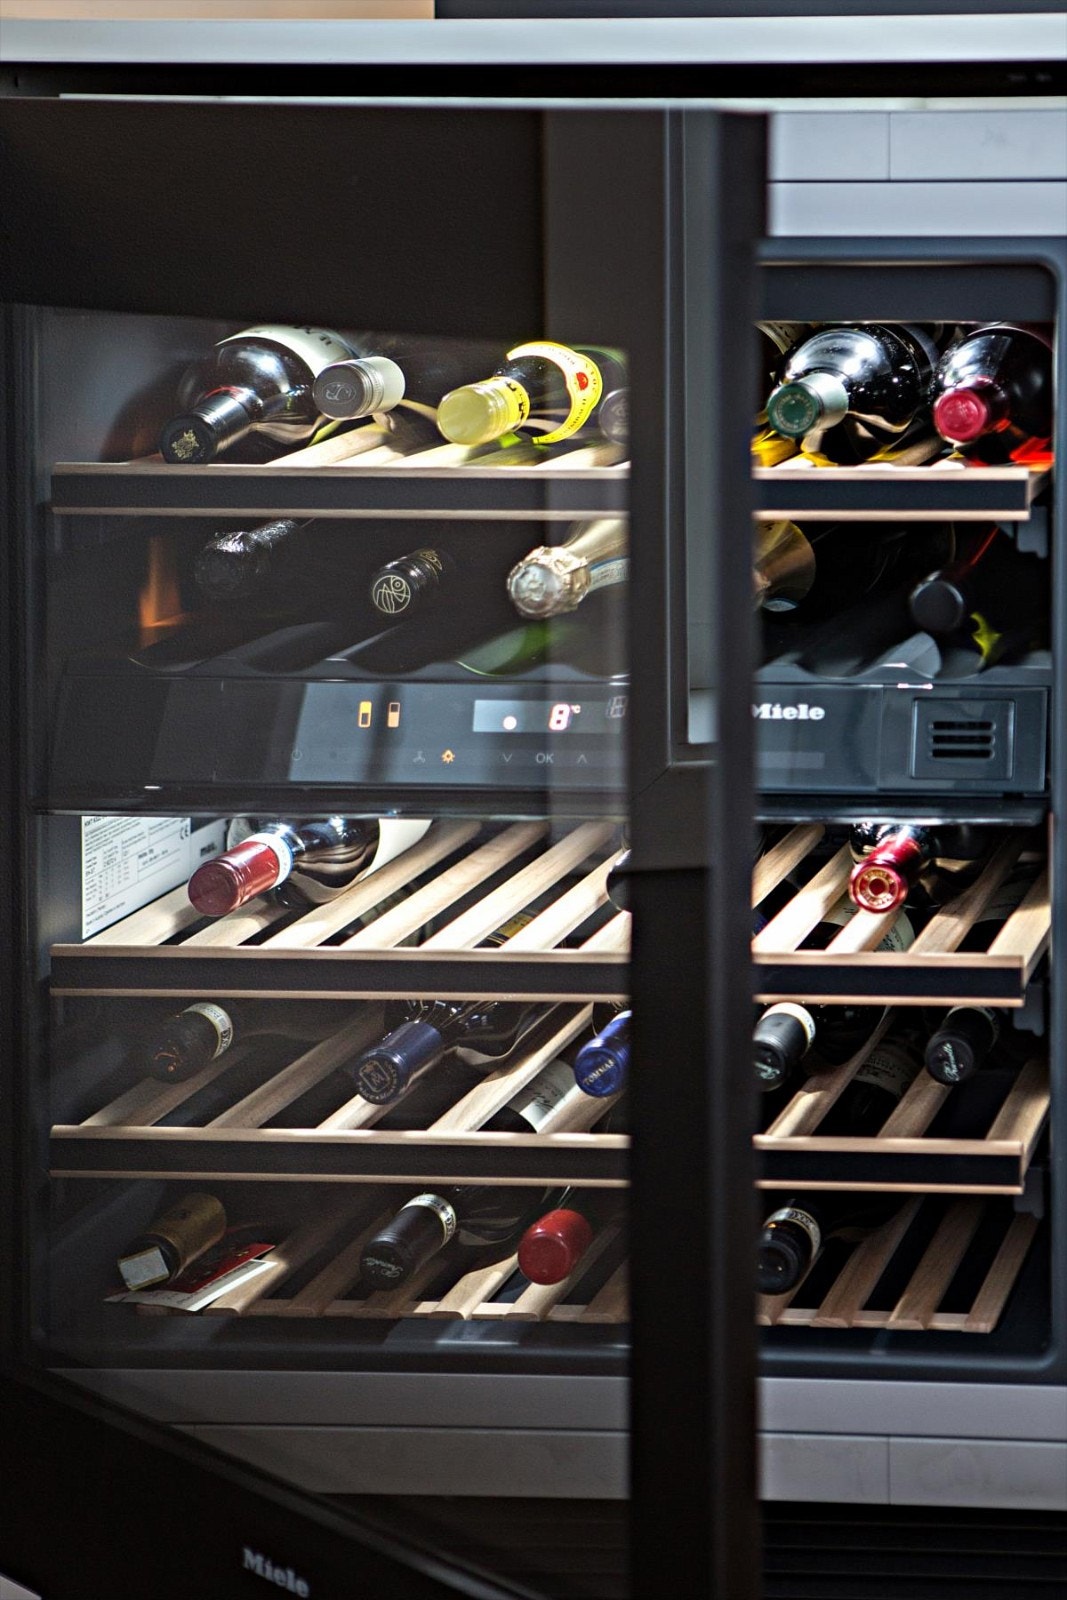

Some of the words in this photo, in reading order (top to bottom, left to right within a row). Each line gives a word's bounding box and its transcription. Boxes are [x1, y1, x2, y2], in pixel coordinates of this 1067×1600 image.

[752, 703, 826, 720] Miele
[536, 752, 554, 764] OK
[243, 1547, 310, 1599] Miele
